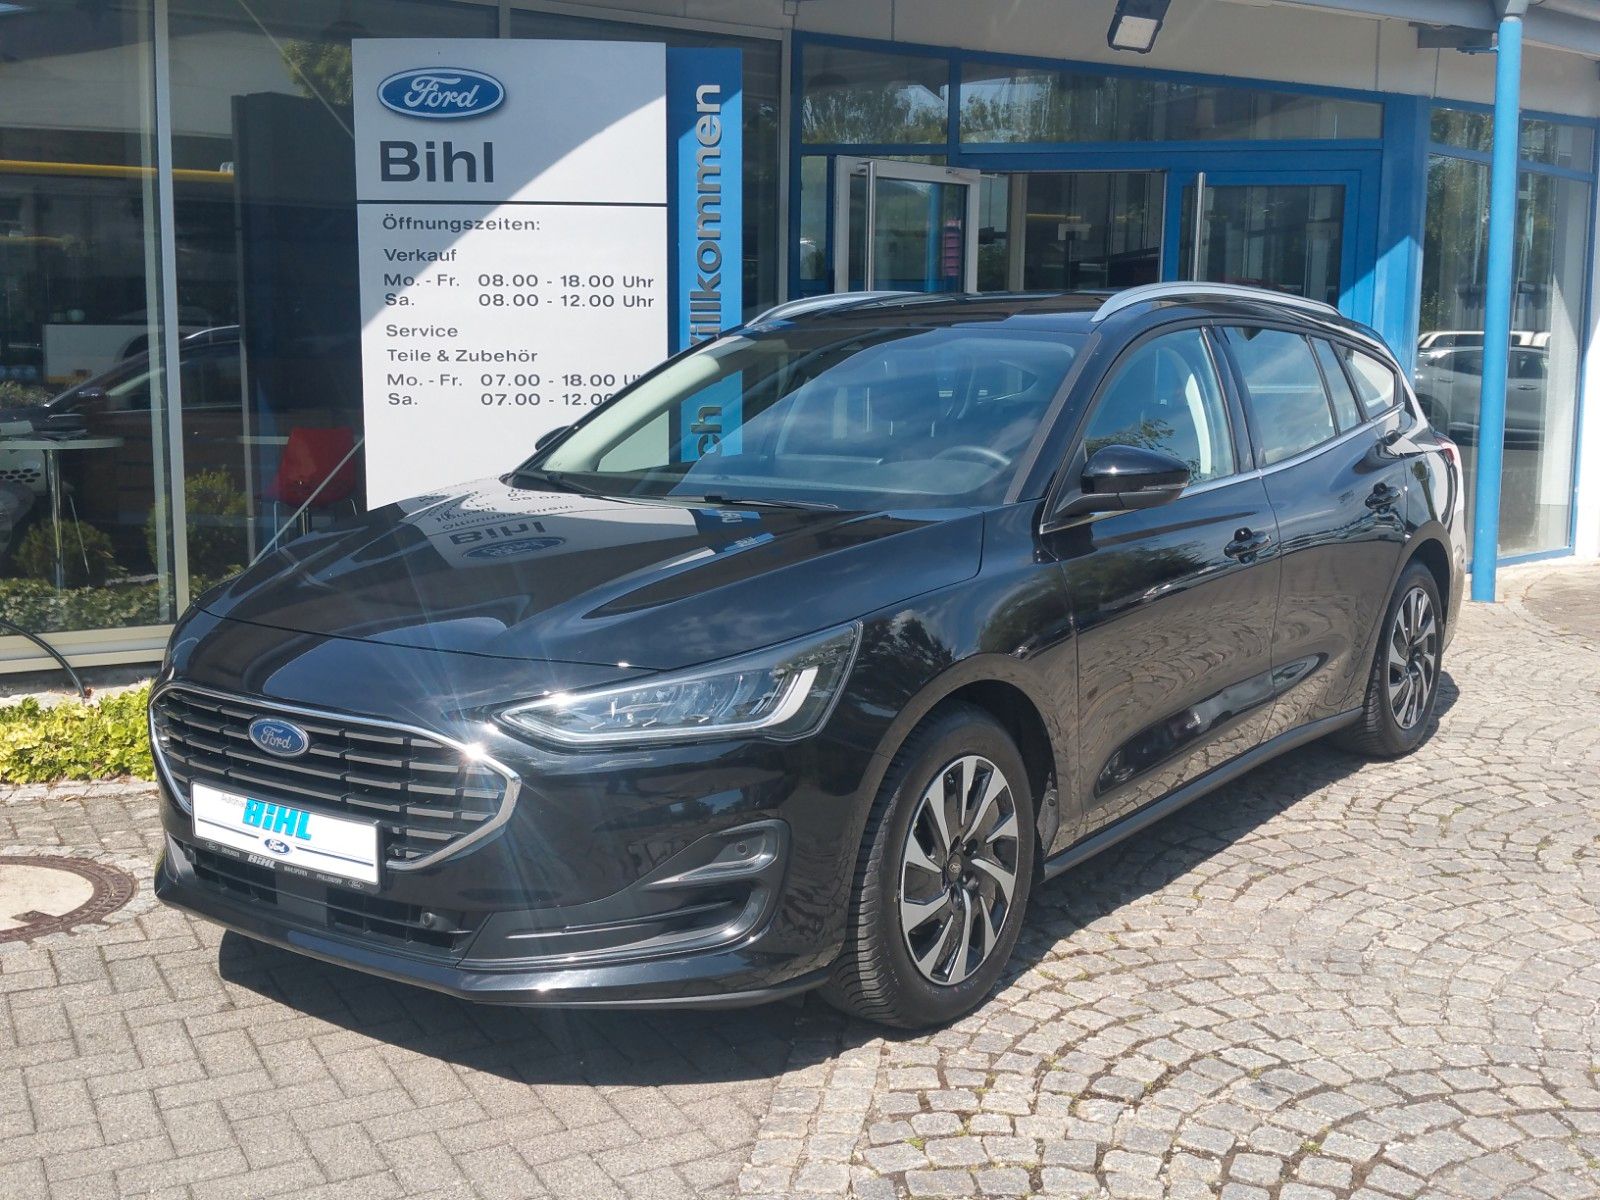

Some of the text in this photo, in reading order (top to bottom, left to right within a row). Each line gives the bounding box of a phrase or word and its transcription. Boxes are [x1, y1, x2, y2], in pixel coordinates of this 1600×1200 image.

[403, 75, 479, 108] Ford
[379, 140, 494, 183] Bihl
[382, 213, 541, 233] Öffnungszeiten:
[384, 248, 457, 262] Verkauf
[383, 273, 420, 287] Mo.
[436, 274, 460, 287] Fr.
[477, 274, 539, 287] 08.00
[560, 275, 615, 288] 18.00
[622, 275, 654, 288] Uhr
[384, 292, 415, 306] Sa.
[478, 293, 539, 307] 08.00
[560, 294, 615, 307] 12.00
[622, 295, 654, 308] Uhr
[386, 324, 458, 338] Service
[387, 349, 538, 363] Teile & Zubehör
[386, 373, 423, 387] Mo.
[439, 373, 463, 387] Fr.
[480, 373, 541, 387] 07.00
[561, 374, 616, 387] 18.00
[387, 392, 418, 406] Sa.
[480, 393, 541, 406] 07.00
[261, 726, 292, 750] Ford
